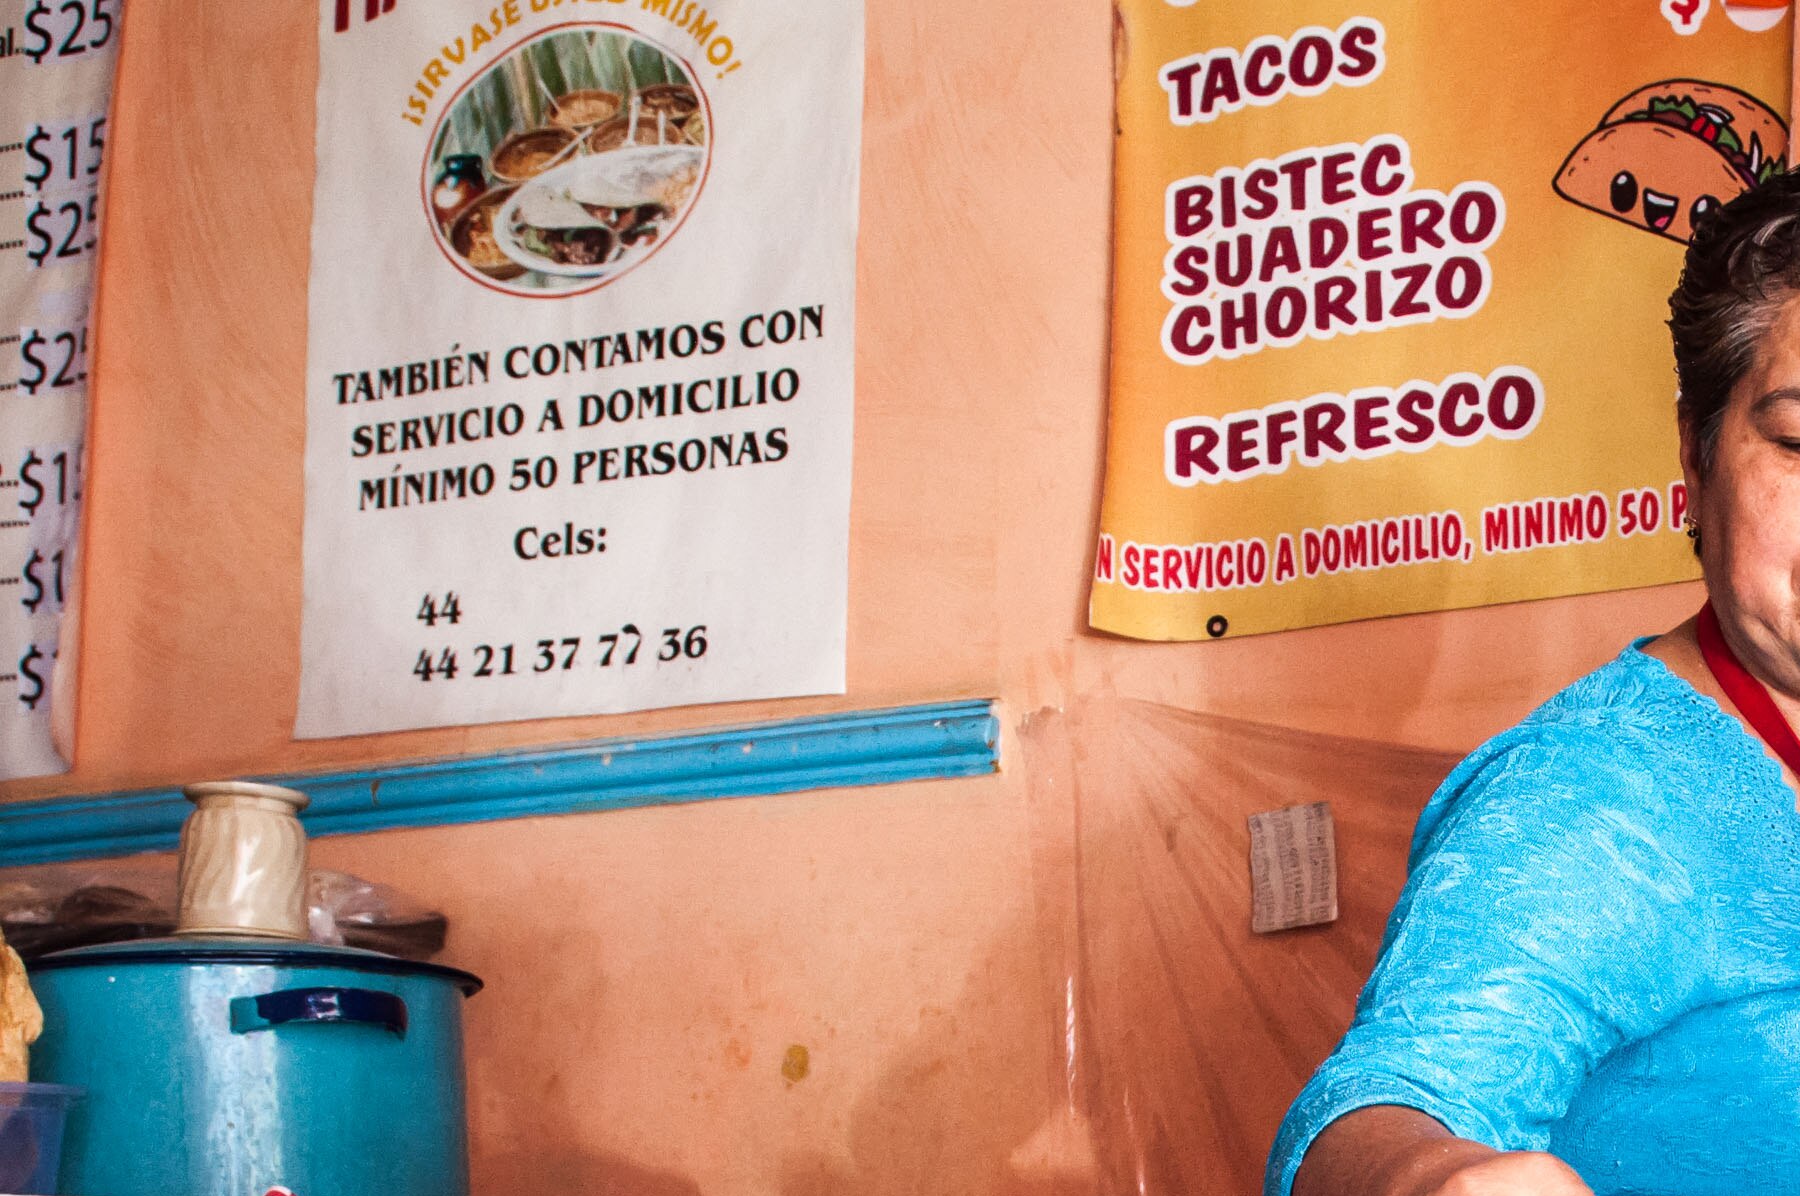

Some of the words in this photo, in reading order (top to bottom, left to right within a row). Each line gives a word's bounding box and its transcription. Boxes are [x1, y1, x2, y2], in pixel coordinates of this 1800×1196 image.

[25, 0, 112, 64] $25
[1167, 26, 1378, 116] TACOS
[25, 117, 105, 191] $15
[1174, 143, 1405, 237] BISTEC
[1171, 190, 1497, 297] SUADERO
[1170, 256, 1483, 357] CHORIZO
[332, 342, 490, 405] TAMBIÉN
[503, 319, 726, 379] CONTAMOS
[739, 304, 824, 348] CON
[351, 402, 525, 457] SERVICIO
[536, 399, 564, 433] A
[578, 367, 800, 428] DOMICILIO
[1173, 374, 1536, 478] REFRESCO
[358, 463, 496, 511] MÍNIMO
[508, 455, 558, 491] 50
[572, 427, 789, 485] PERSONAS
[513, 521, 607, 561] Cels:
[1123, 540, 1266, 589] SERVICIO
[1276, 536, 1296, 582] A
[1304, 512, 1472, 576] DOMICILIO,
[1484, 494, 1608, 552] MINIMO
[1620, 491, 1660, 536] 50
[412, 645, 459, 682] 44
[472, 643, 518, 678] 21
[532, 636, 581, 673] 37
[657, 624, 708, 662] 36
[416, 590, 462, 627] 44
